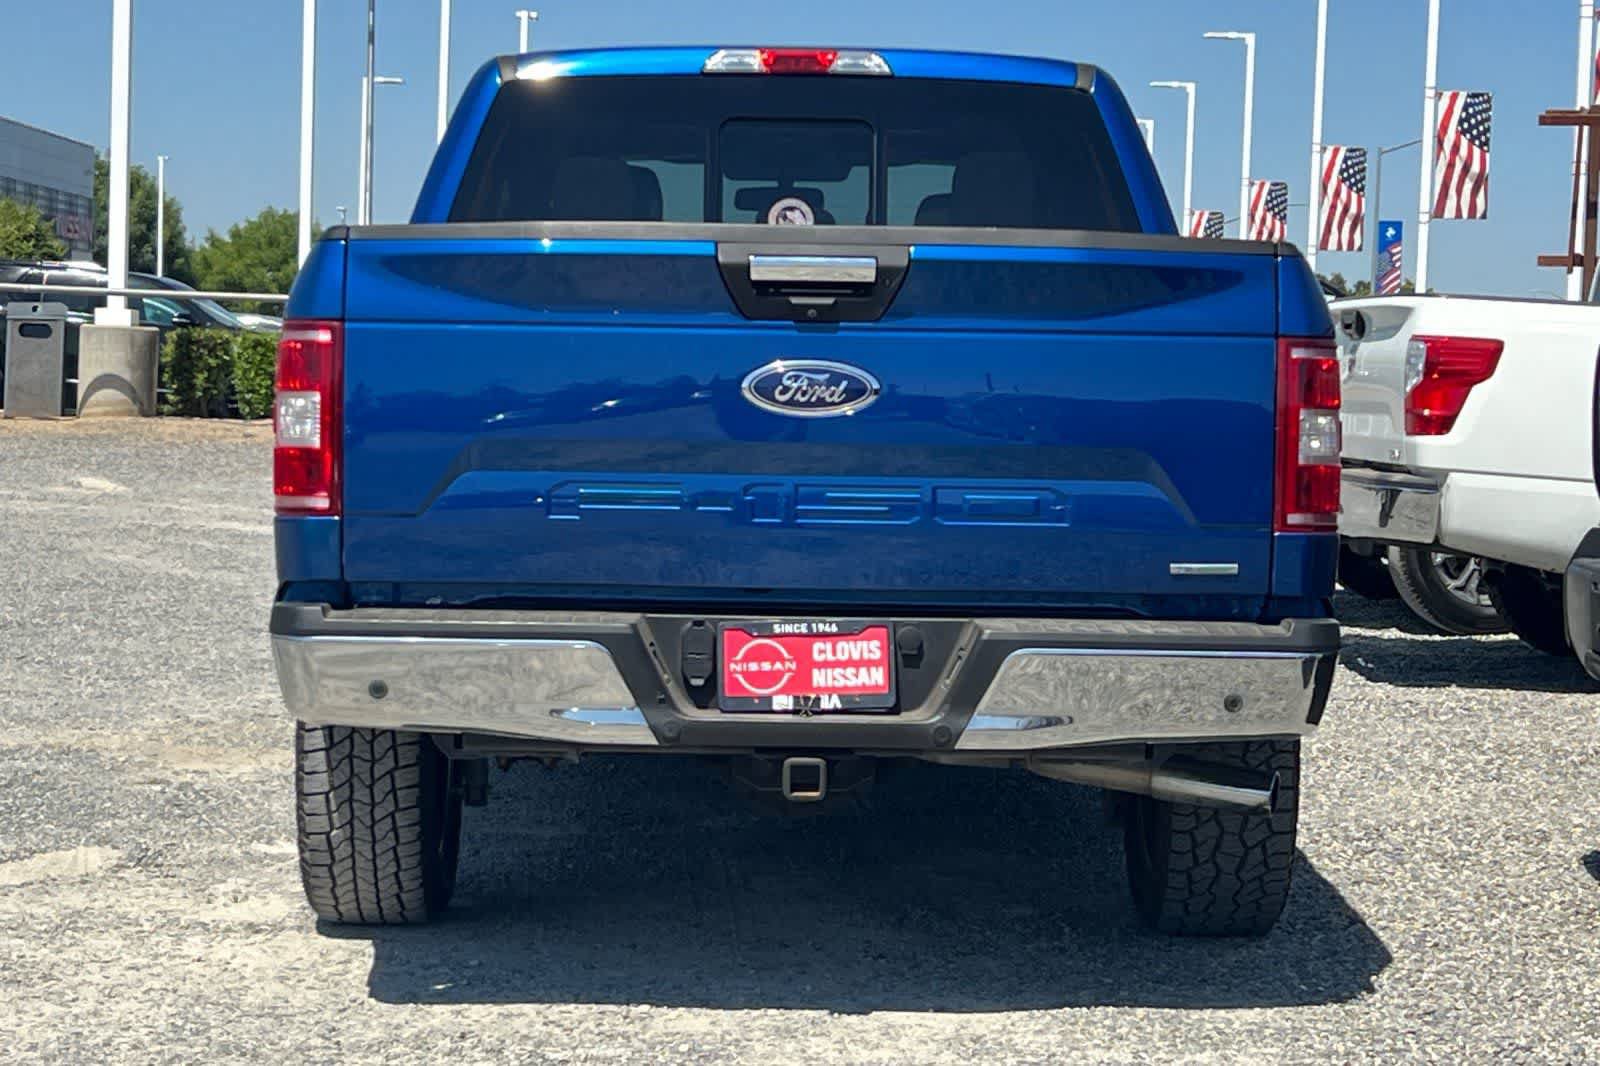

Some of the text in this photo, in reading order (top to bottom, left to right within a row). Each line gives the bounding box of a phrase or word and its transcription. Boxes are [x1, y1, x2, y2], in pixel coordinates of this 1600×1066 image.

[774, 371, 848, 402] Ford
[546, 481, 1071, 527] F-150
[773, 623, 838, 633] SINCE 1946
[812, 640, 881, 661] CLOVIS
[729, 660, 797, 672] NISSAN
[812, 666, 885, 688] NISSAN
